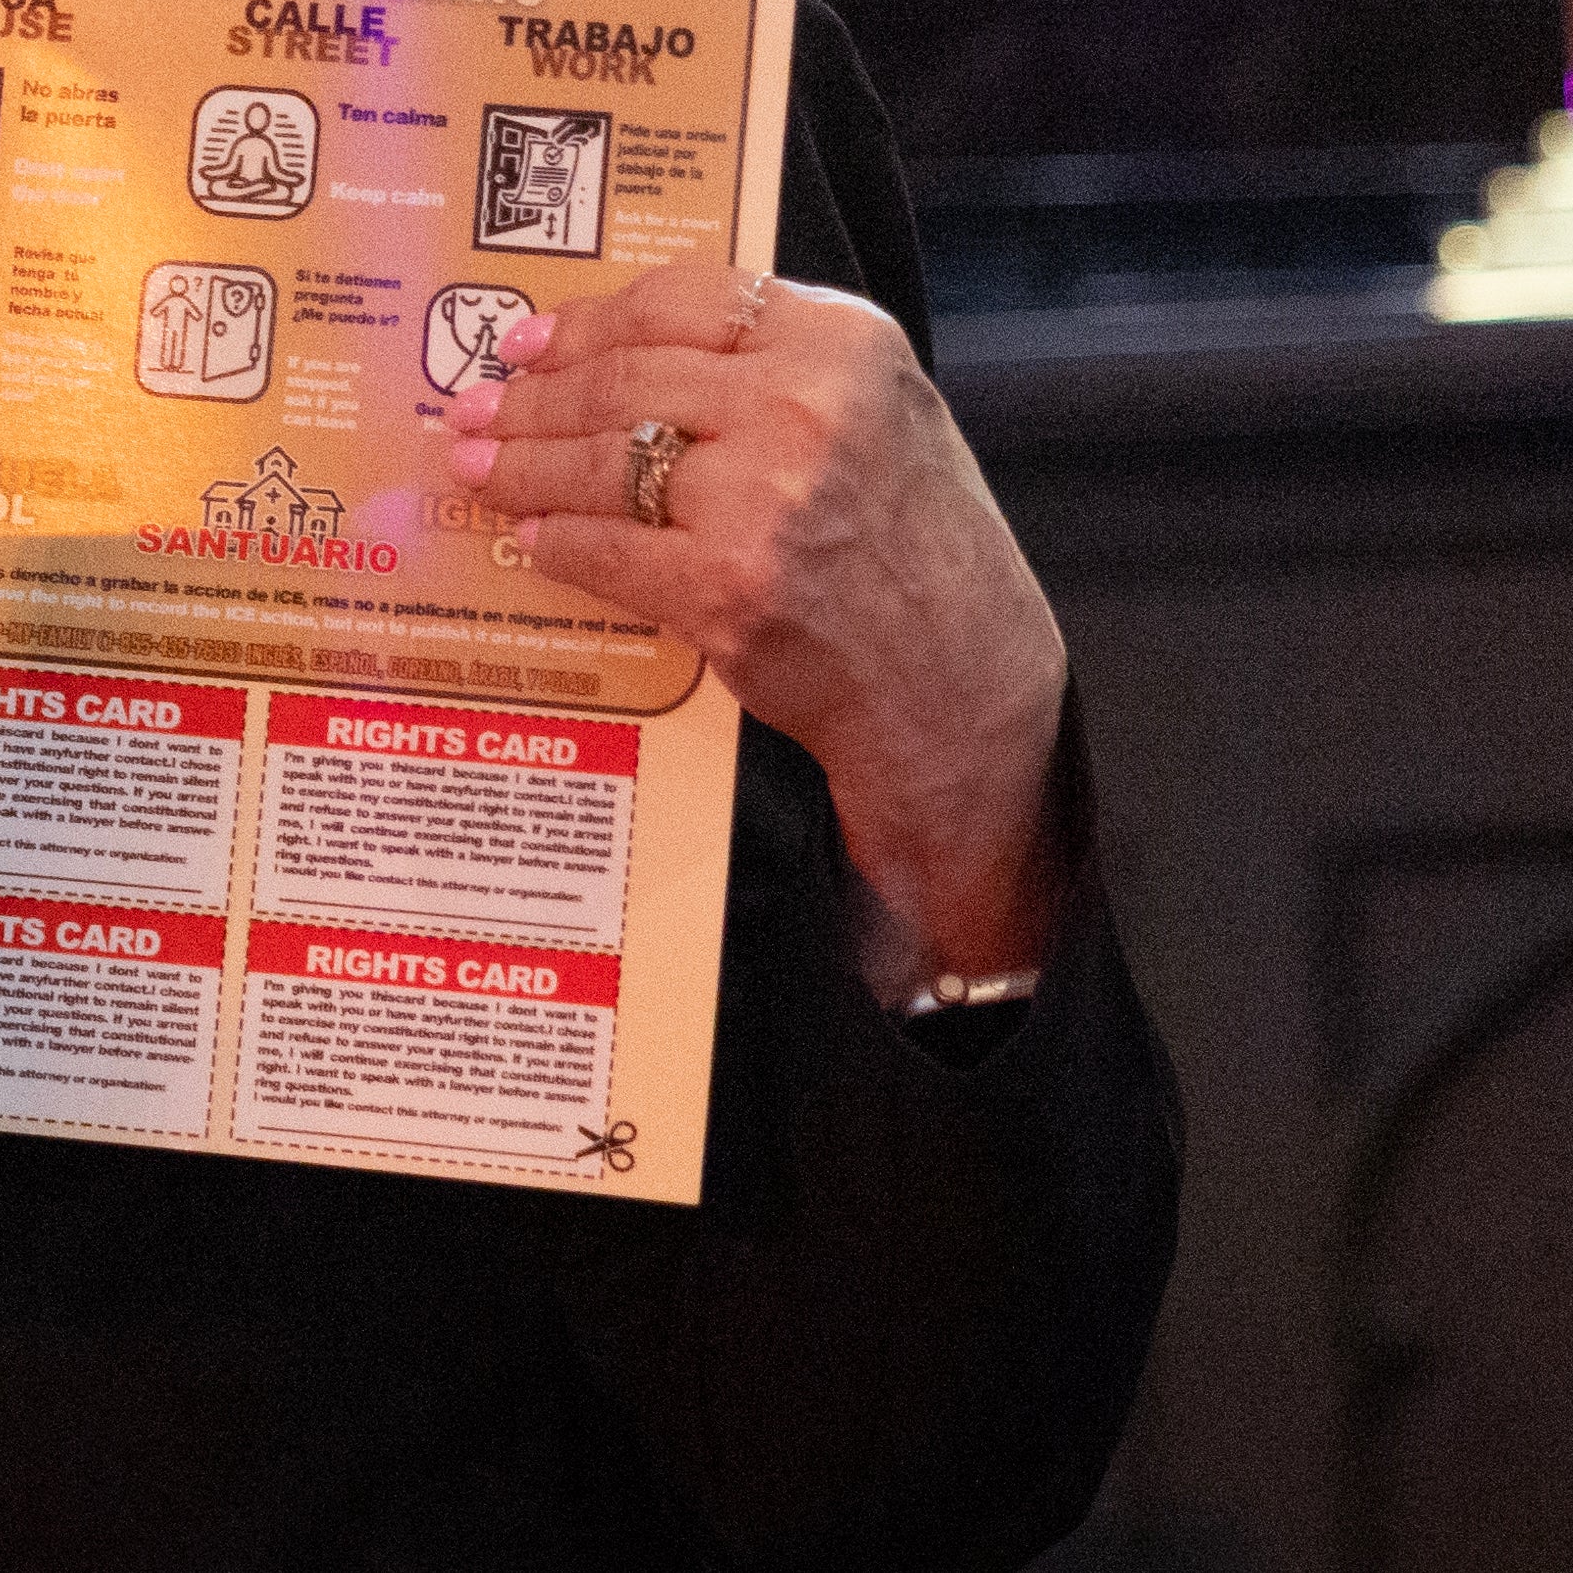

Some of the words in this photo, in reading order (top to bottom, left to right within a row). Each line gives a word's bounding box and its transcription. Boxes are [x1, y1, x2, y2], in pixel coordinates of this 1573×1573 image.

[225, 25, 398, 67] STREET
[497, 16, 696, 60] TRABAJO
[530, 45, 658, 86] WORK
[22, 79, 52, 97] No
[58, 82, 119, 103] abras
[20, 105, 38, 123] la
[45, 109, 116, 132] puerta
[337, 102, 378, 123] Ten
[382, 106, 448, 128] calma
[136, 523, 399, 575] SANTUARIO
[74, 693, 182, 730] CARD
[326, 716, 468, 756] RIGHTS
[475, 729, 578, 766] CARD
[55, 920, 161, 958] CARD
[305, 944, 447, 986] RIGHTS
[455, 959, 559, 996] CARD
